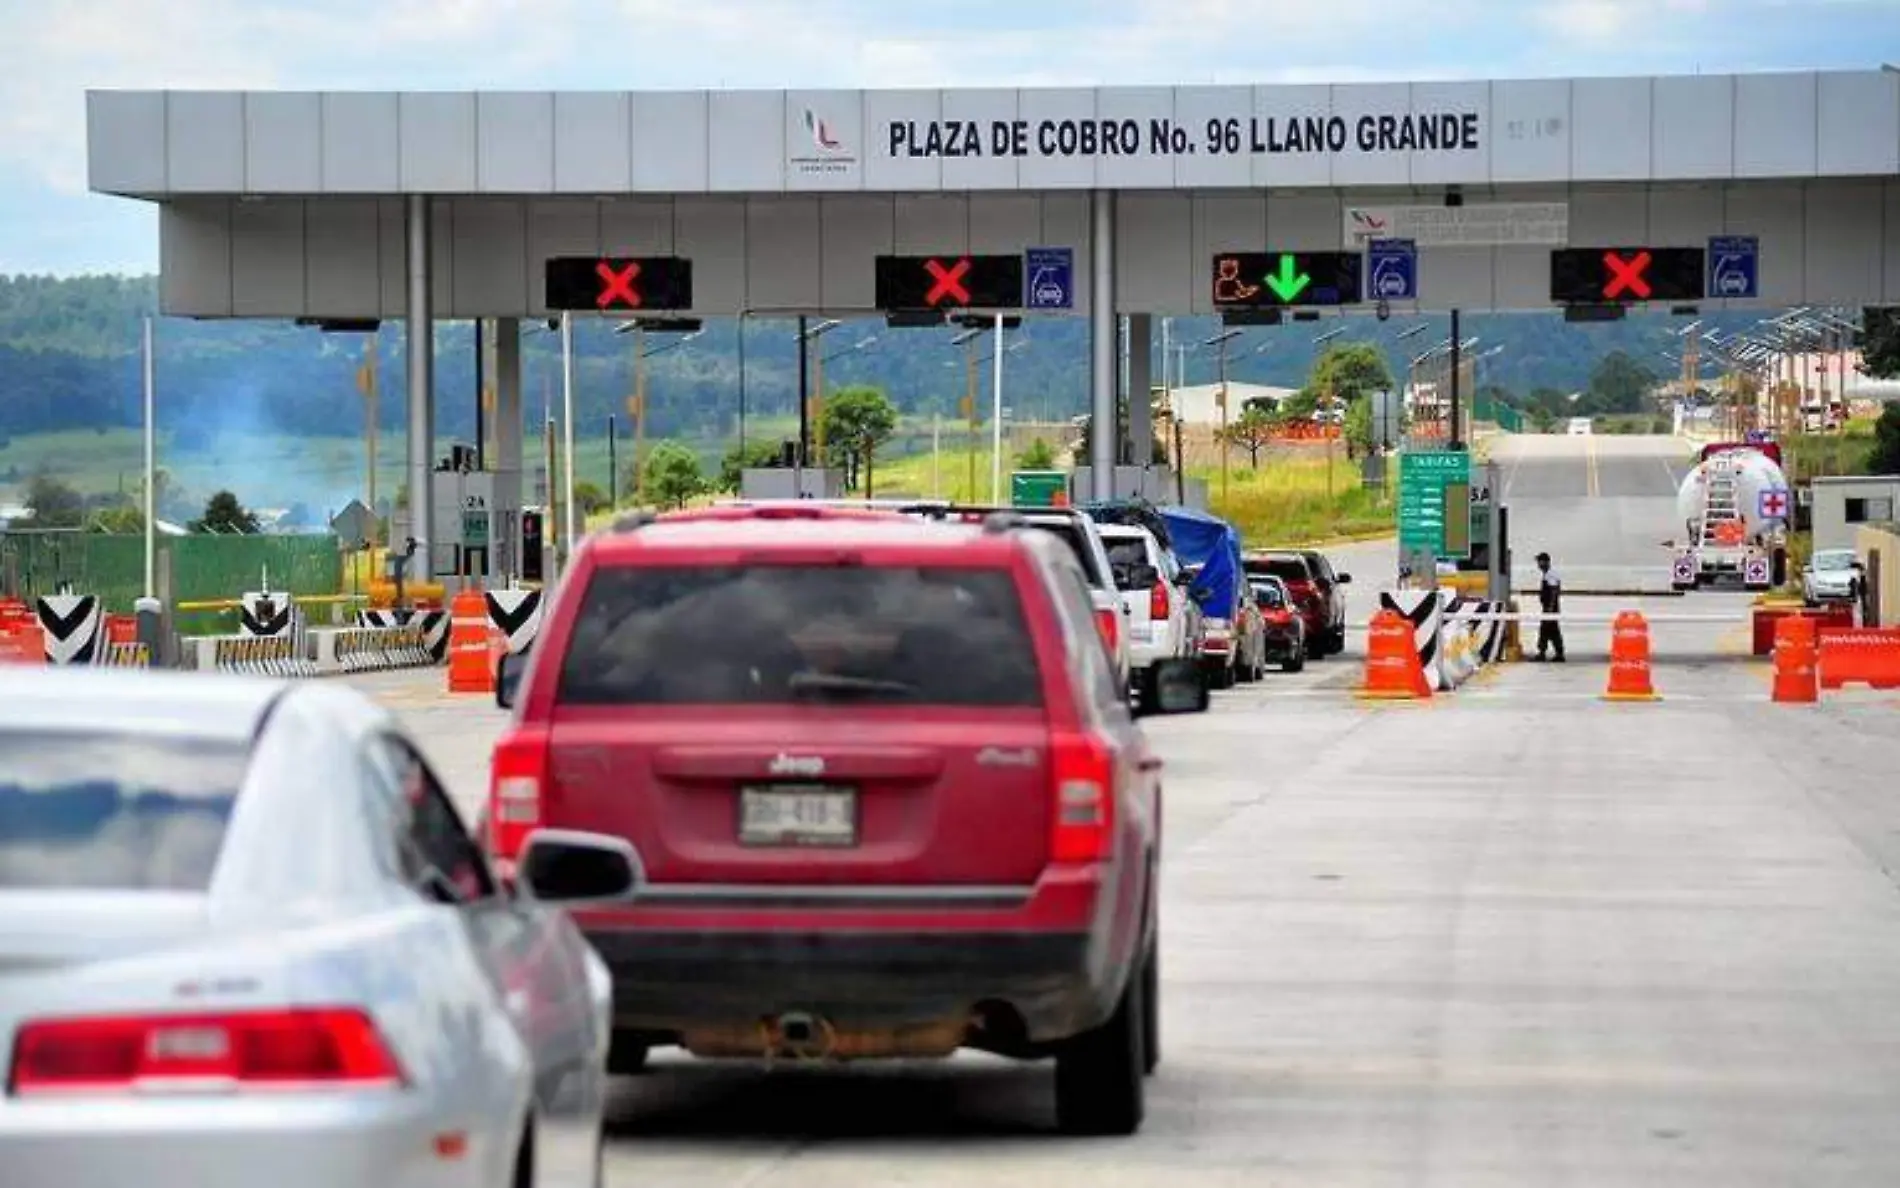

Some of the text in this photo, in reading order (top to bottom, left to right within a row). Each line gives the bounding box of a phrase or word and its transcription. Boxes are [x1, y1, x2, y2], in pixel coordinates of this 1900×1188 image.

[889, 121, 981, 157] PLAZA
[991, 121, 1028, 156] DE
[1038, 119, 1139, 155] COBRO
[1150, 118, 1195, 154] No.
[1207, 118, 1240, 154] 96
[1251, 116, 1346, 152] LLANO
[1356, 113, 1478, 151] GRANDE
